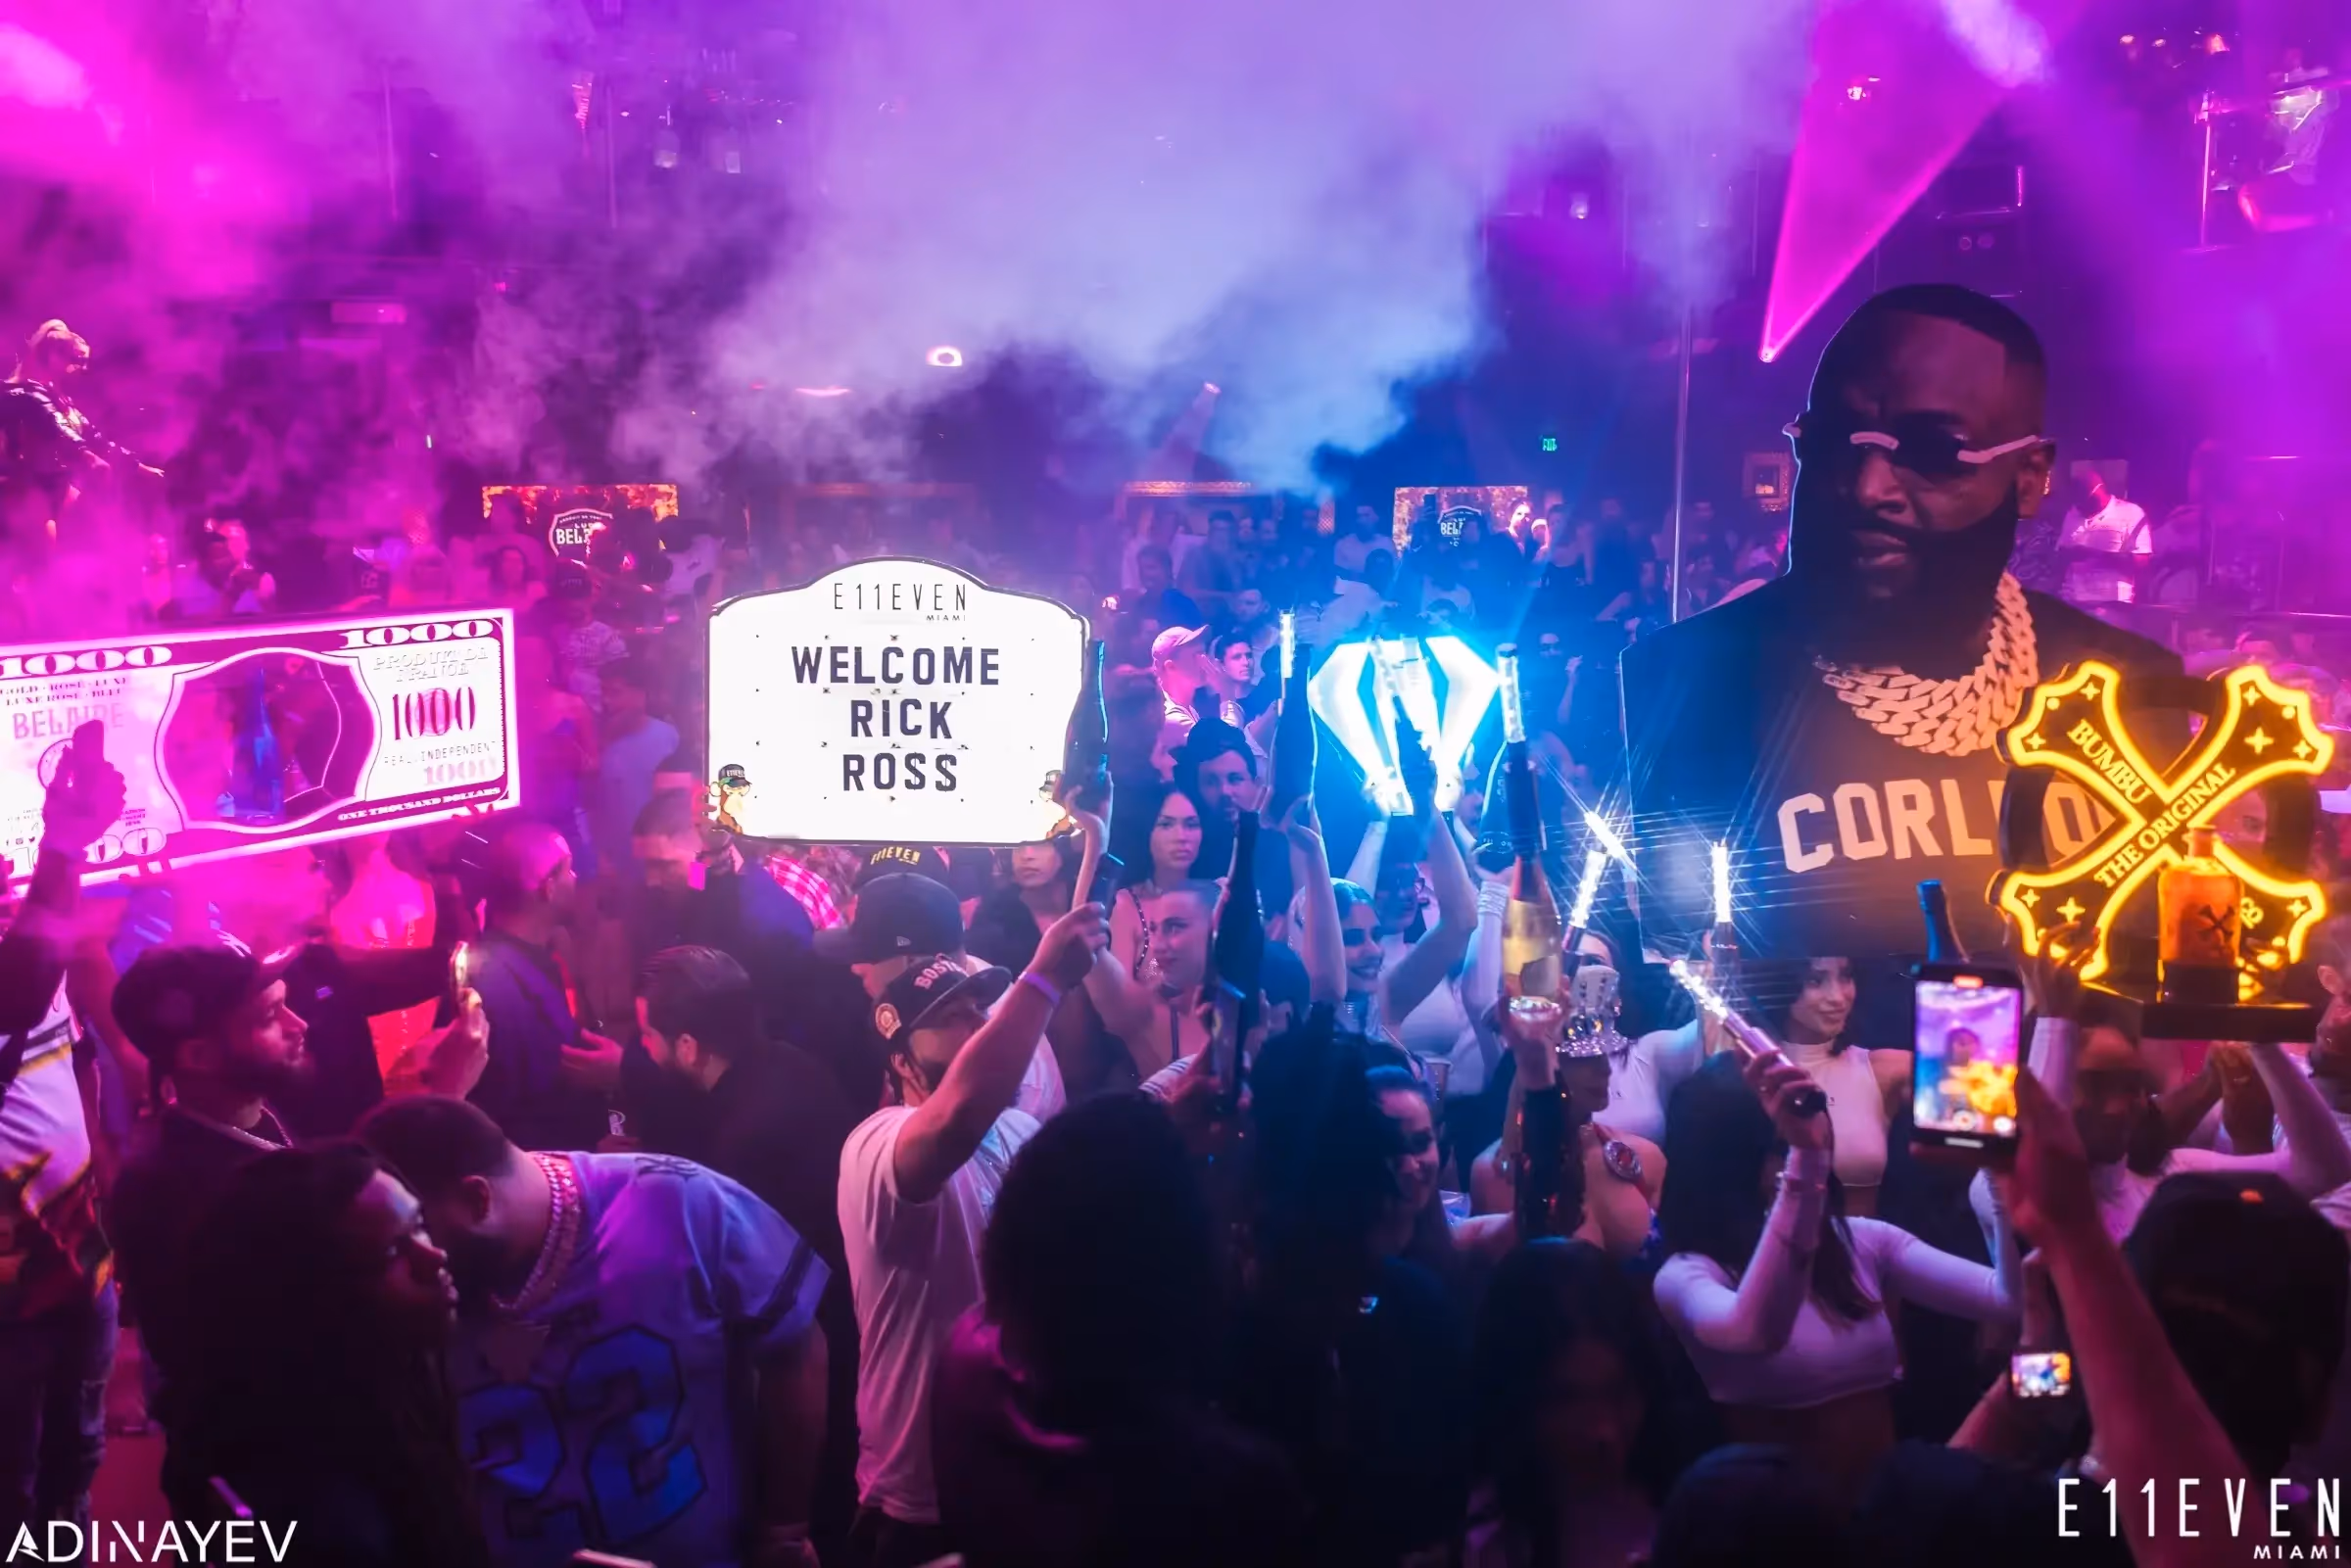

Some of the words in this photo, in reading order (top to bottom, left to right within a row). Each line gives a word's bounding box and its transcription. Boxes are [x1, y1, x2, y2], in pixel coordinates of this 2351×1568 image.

[834, 583, 966, 611] E11EVEN
[339, 620, 494, 649] 1000
[0, 645, 172, 679] 1000
[792, 646, 999, 686] WELCOME
[393, 687, 475, 740] 1000
[850, 698, 953, 739] RICK
[2066, 718, 2155, 803] BUMBU
[1777, 779, 2118, 874] CORLO
[2093, 843, 2144, 888] THE
[2137, 762, 2236, 850] ORIGINAL
[914, 959, 970, 990] BOST
